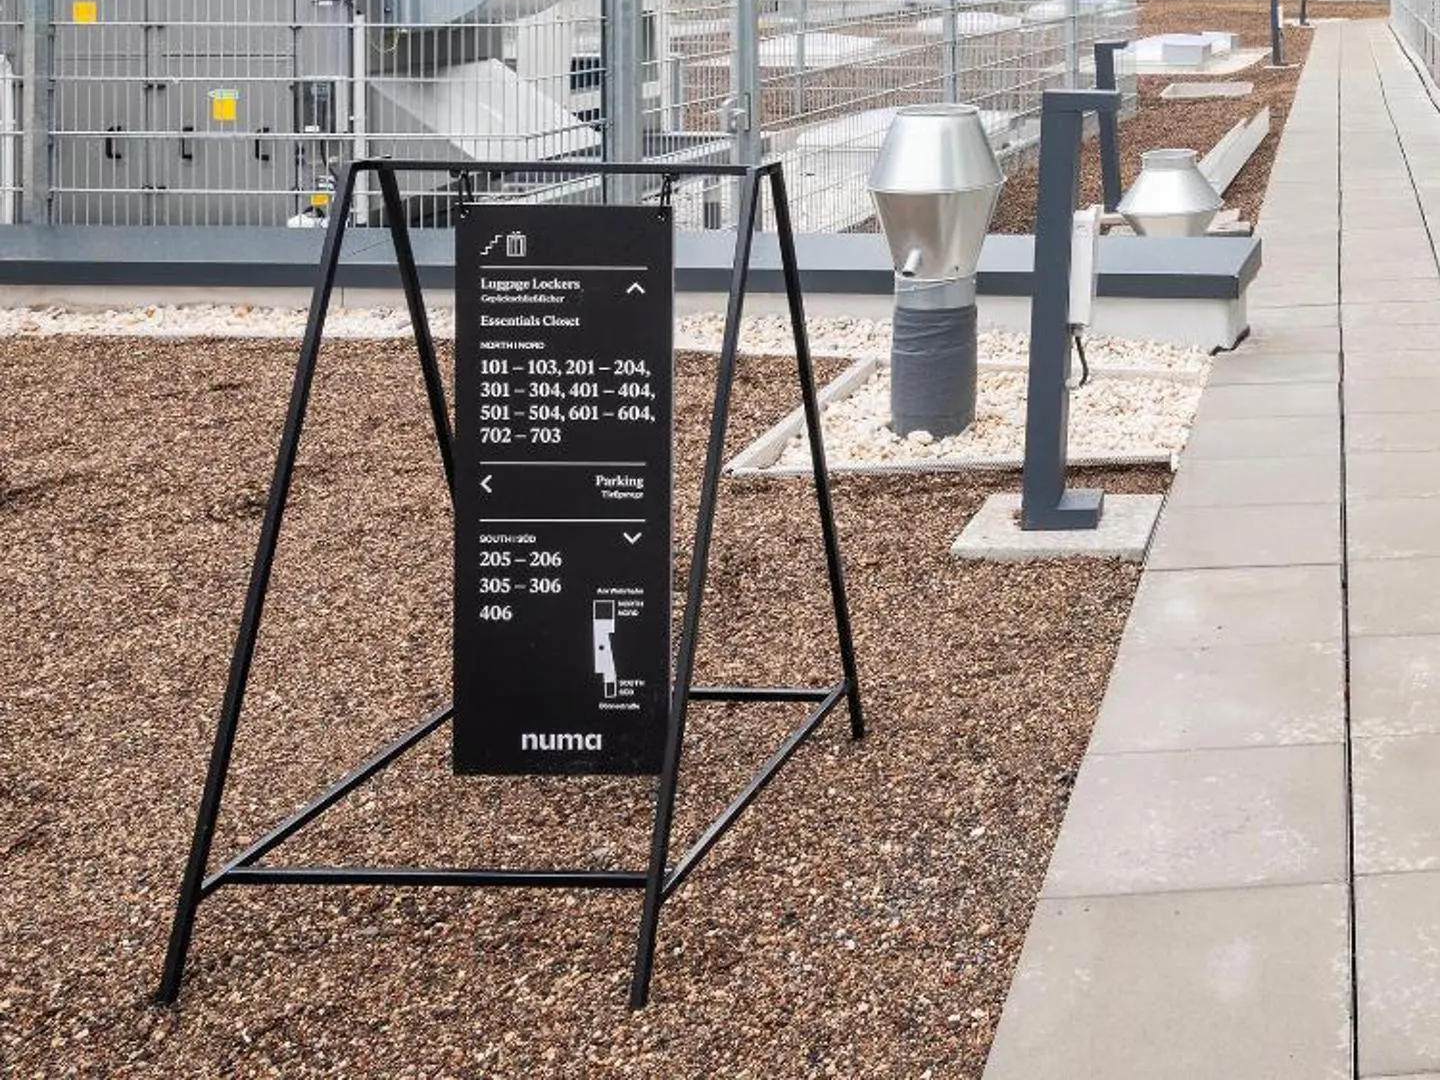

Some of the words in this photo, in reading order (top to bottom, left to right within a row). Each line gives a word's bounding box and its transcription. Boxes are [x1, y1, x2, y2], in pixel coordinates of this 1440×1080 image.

[481, 278, 530, 292] Luggage
[533, 278, 581, 290] Lockers
[480, 315, 540, 326] Essentials
[543, 315, 580, 326] Closet
[480, 359, 509, 374] 101
[528, 359, 562, 376] 103,
[565, 359, 595, 374] 201
[614, 359, 651, 376] 204,
[480, 382, 510, 397] 301
[529, 382, 565, 399] 304,
[569, 382, 599, 397] 401
[618, 383, 656, 399] 404,
[480, 405, 510, 420] 501
[529, 405, 565, 422] 504,
[569, 405, 599, 420] 601
[618, 405, 656, 422] 604,
[480, 427, 511, 443] 702
[530, 427, 561, 443] 703
[596, 475, 644, 489] Parking
[480, 551, 511, 567] 205
[529, 551, 562, 567] 206
[480, 578, 511, 593] 305
[529, 578, 561, 593] 306
[480, 605, 512, 620] 406
[521, 732, 602, 750] numa
